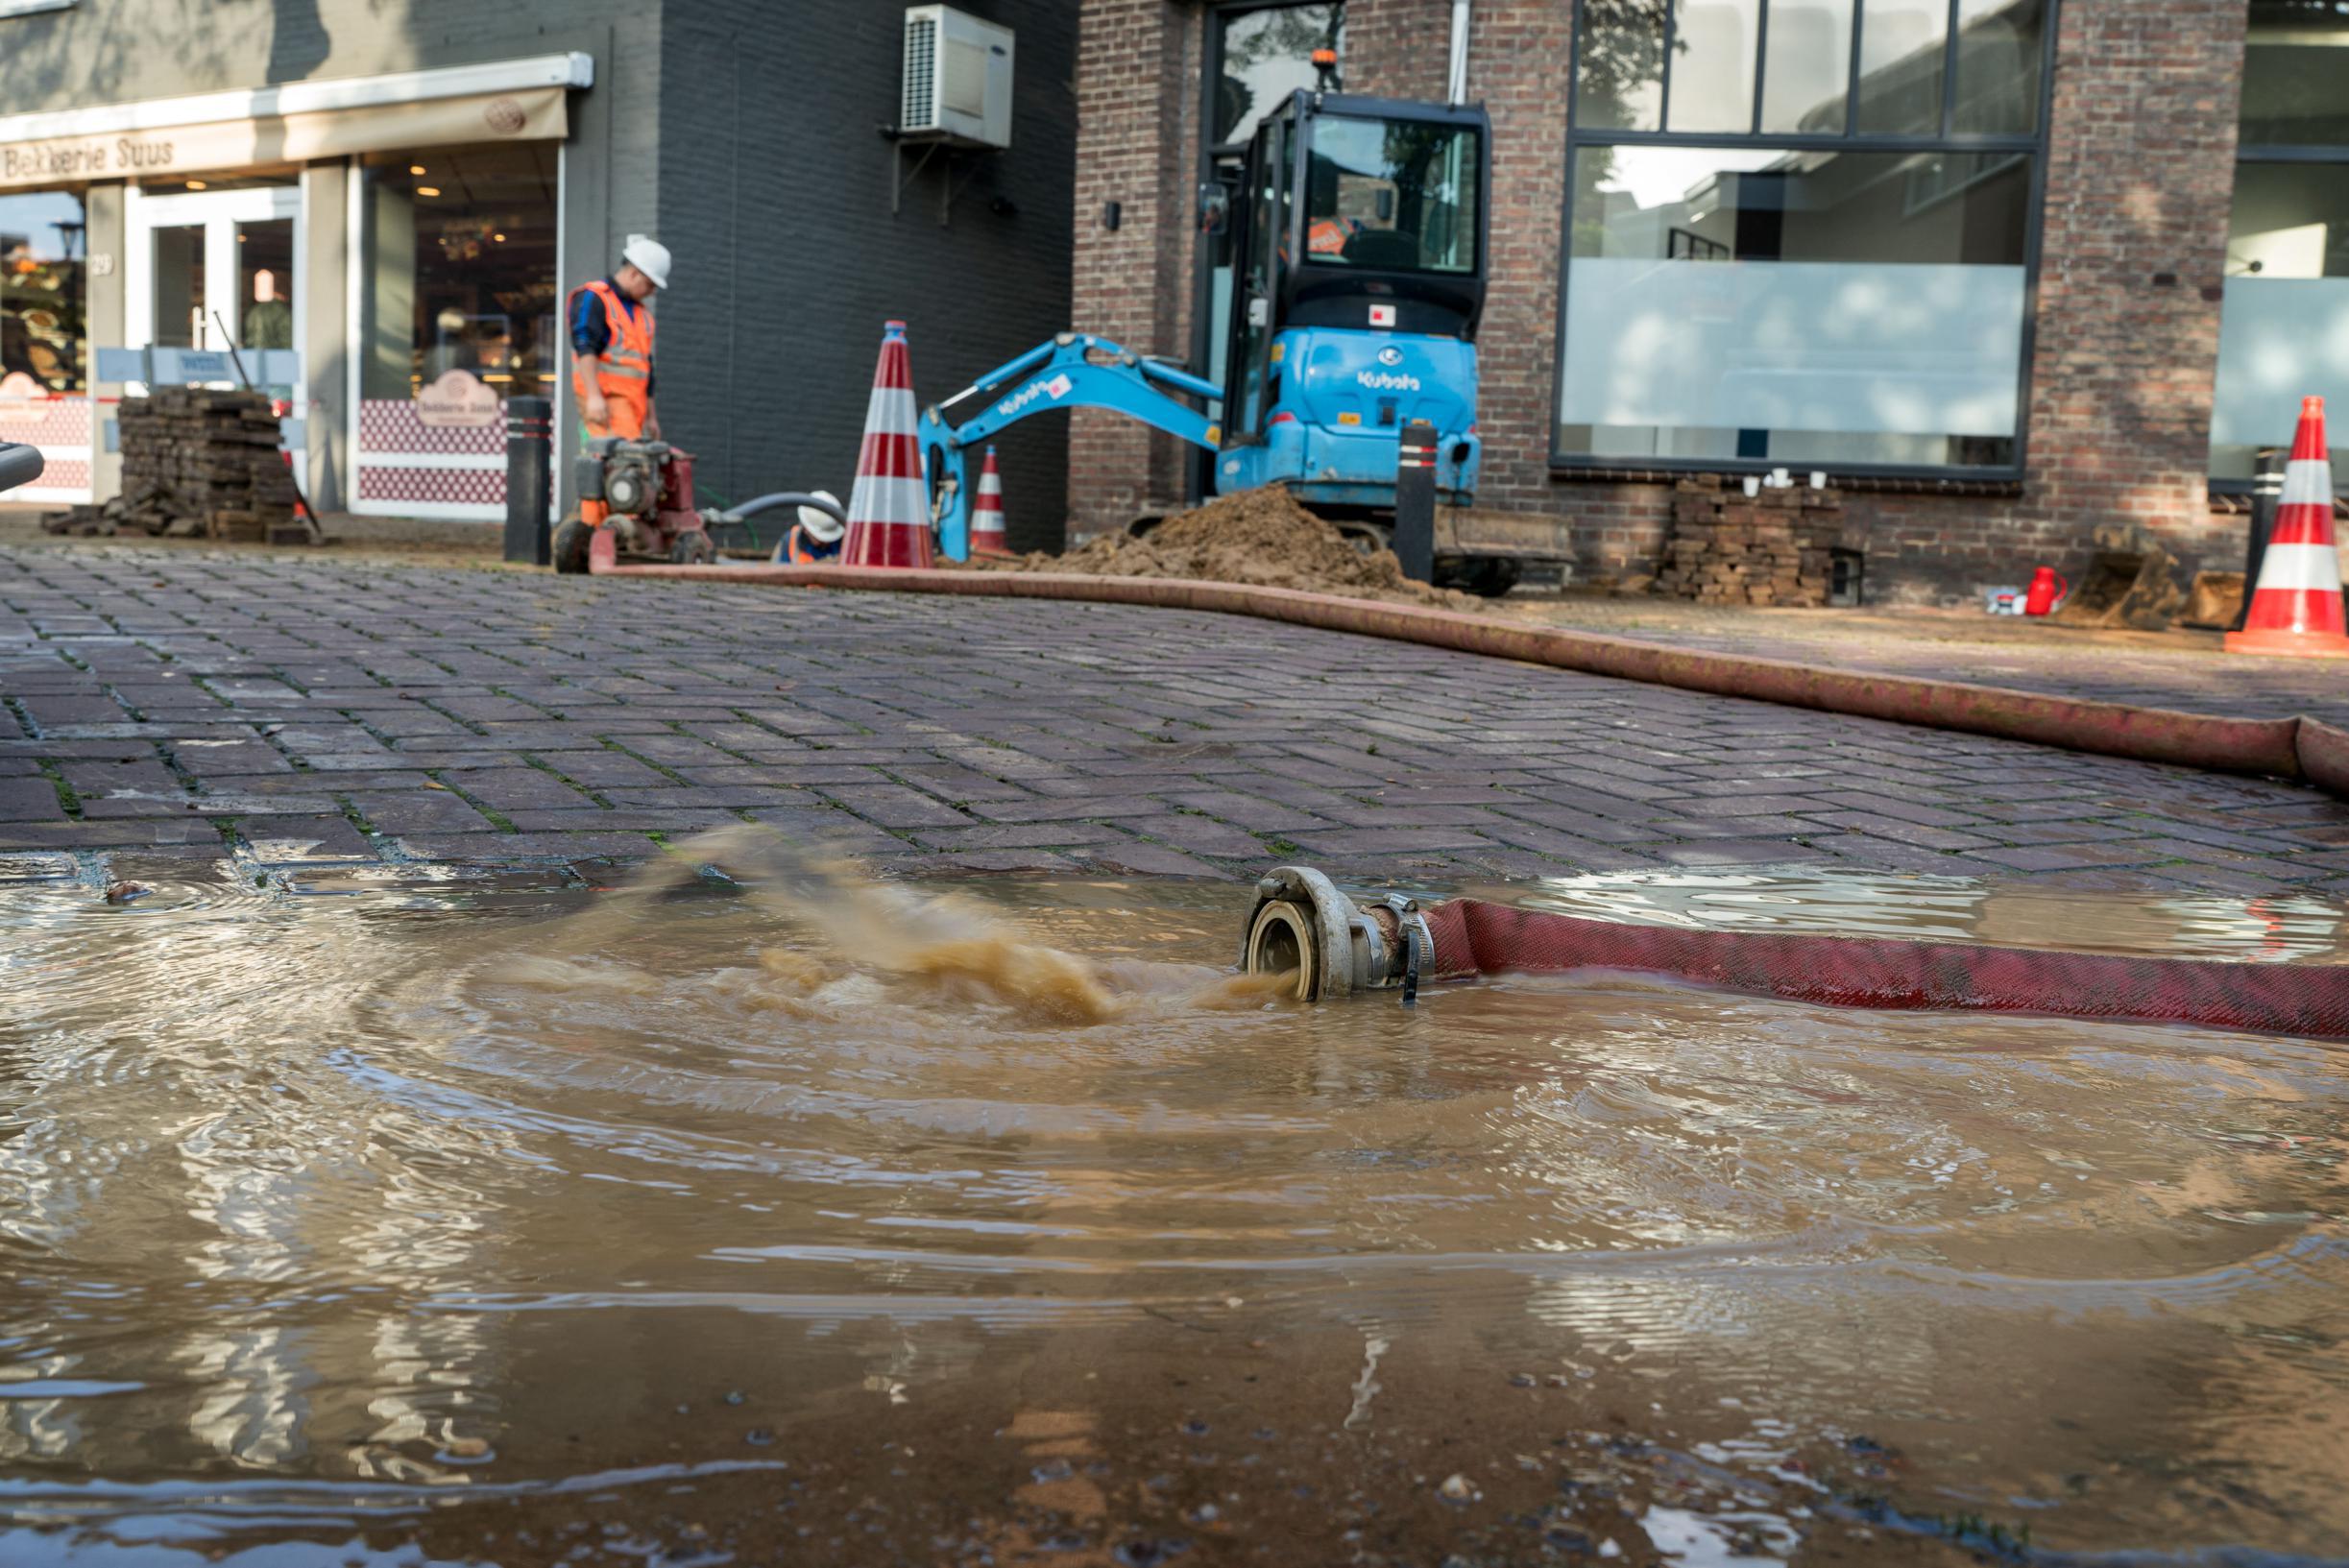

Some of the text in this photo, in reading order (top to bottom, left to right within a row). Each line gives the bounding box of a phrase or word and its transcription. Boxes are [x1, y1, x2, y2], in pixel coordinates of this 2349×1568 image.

[117, 138, 174, 168] Suus
[1357, 371, 1420, 392] Kubota
[999, 380, 1048, 415] Kubota
